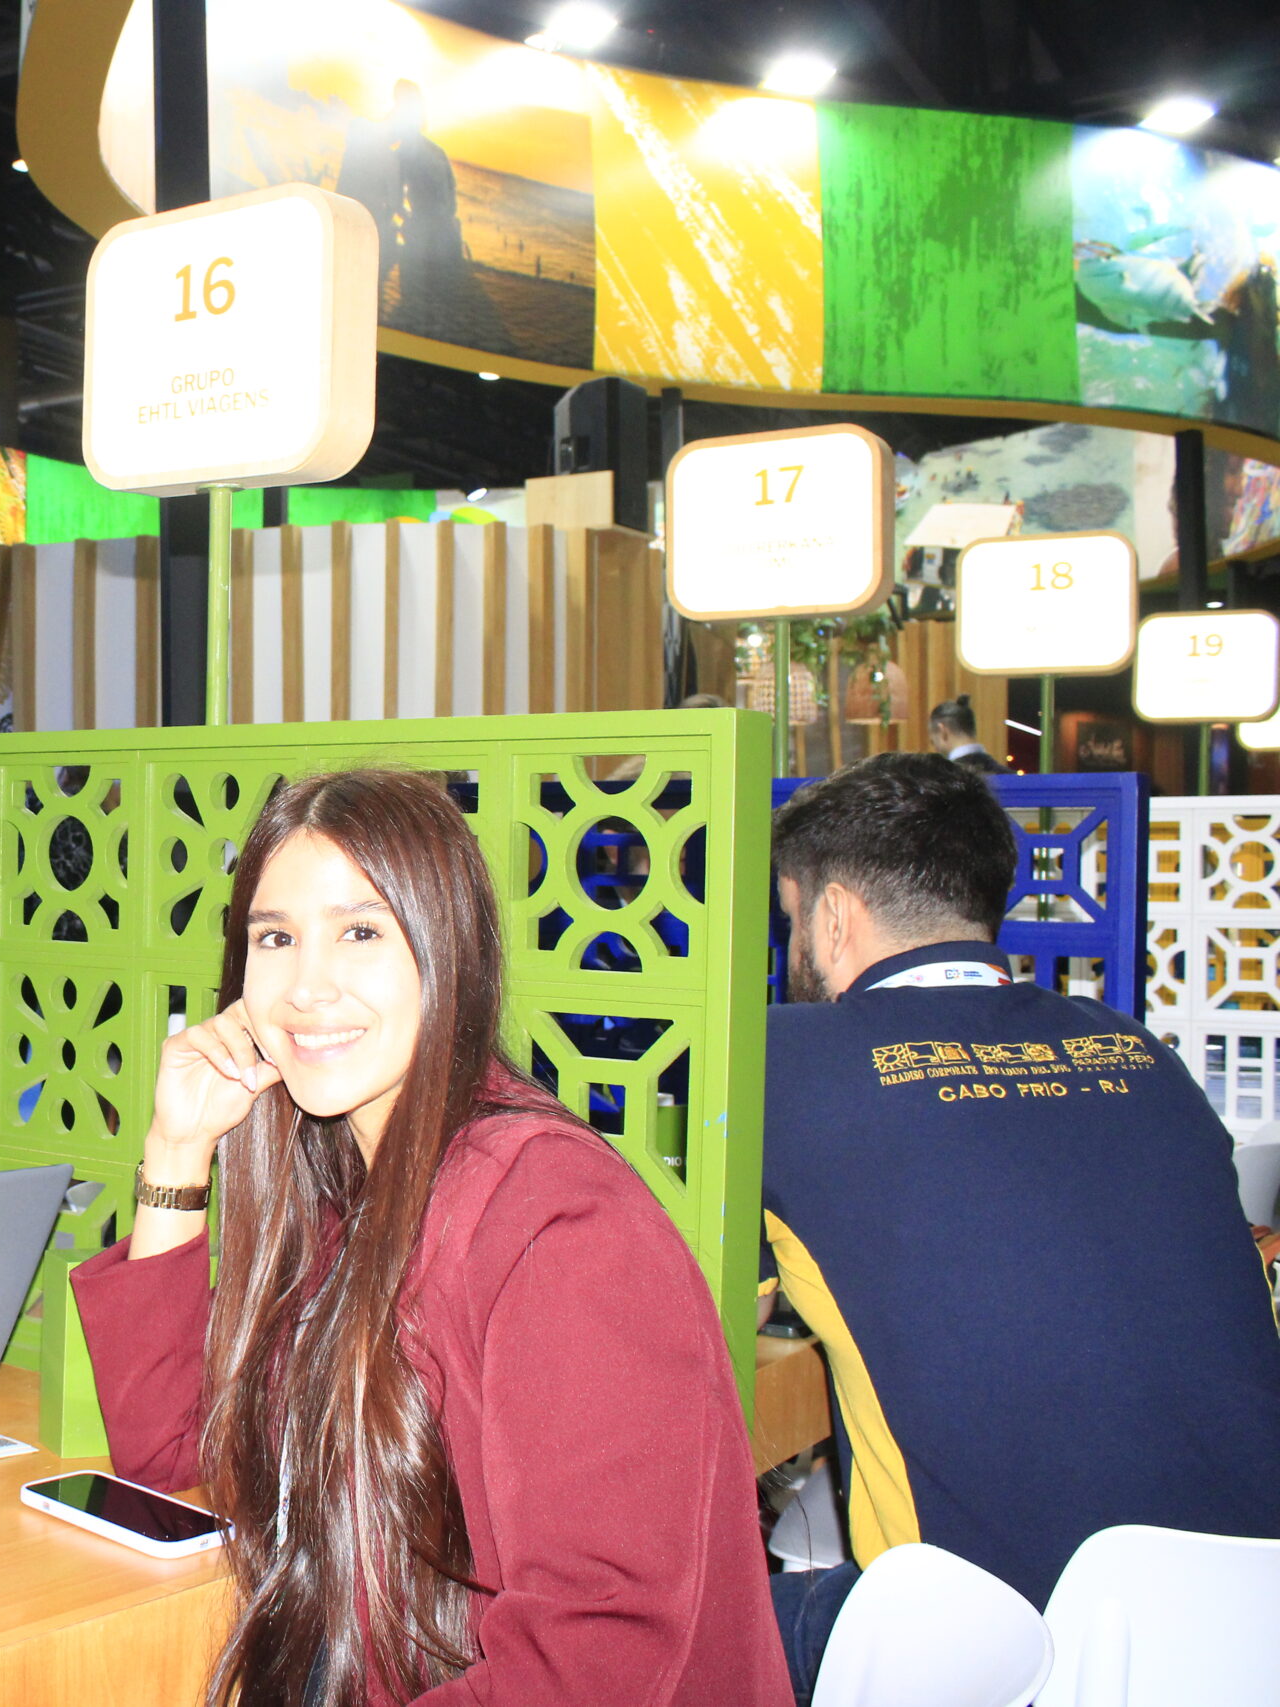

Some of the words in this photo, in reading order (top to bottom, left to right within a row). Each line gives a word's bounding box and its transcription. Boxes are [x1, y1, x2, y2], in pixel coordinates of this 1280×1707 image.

[174, 256, 236, 322] 16
[171, 367, 234, 394] GRUPO
[137, 402, 182, 424] EHTL
[187, 388, 270, 417] VIAGENS
[754, 465, 804, 506] 17
[1028, 562, 1074, 591] 18
[1186, 633, 1224, 658] 19
[879, 1069, 924, 1087] PARADISO
[926, 1065, 979, 1079] CORPORATE
[938, 1081, 1008, 1102] CABO
[1016, 1081, 1069, 1098] FRIO
[1098, 1078, 1130, 1094] RJ
